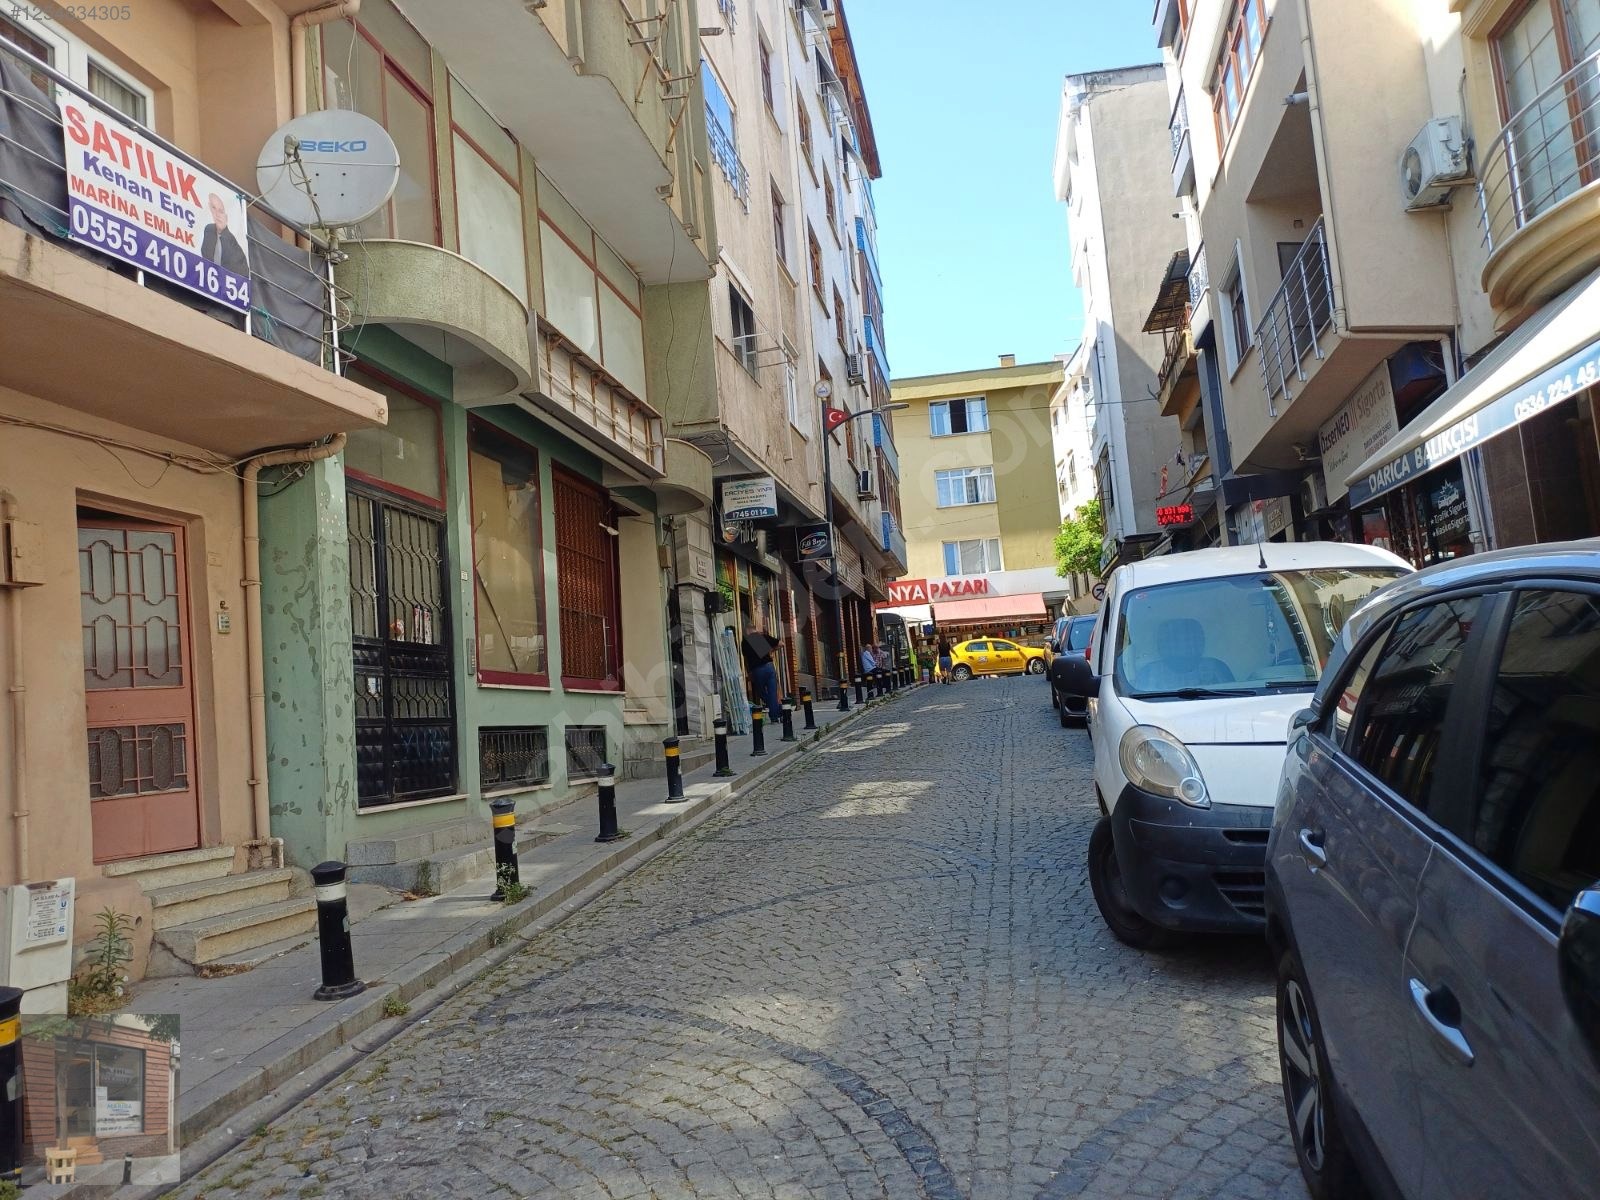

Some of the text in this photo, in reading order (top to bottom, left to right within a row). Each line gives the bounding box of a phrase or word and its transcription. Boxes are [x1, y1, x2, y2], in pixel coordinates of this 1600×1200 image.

[65, 105, 203, 209] SATILIK
[298, 140, 367, 153] BEKO
[71, 174, 196, 248] MARİNA EMLAK
[83, 150, 195, 228] Kenan Enç
[72, 204, 250, 307] 0555 410 16 54
[1357, 380, 1386, 419] Sigorta
[1513, 389, 1546, 421] 0536
[1546, 374, 1574, 407] 224
[1576, 360, 1597, 390] 45
[1368, 453, 1411, 493] DARICA
[1414, 413, 1479, 469] BALIKÇISI
[929, 578, 988, 599] PAZARI
